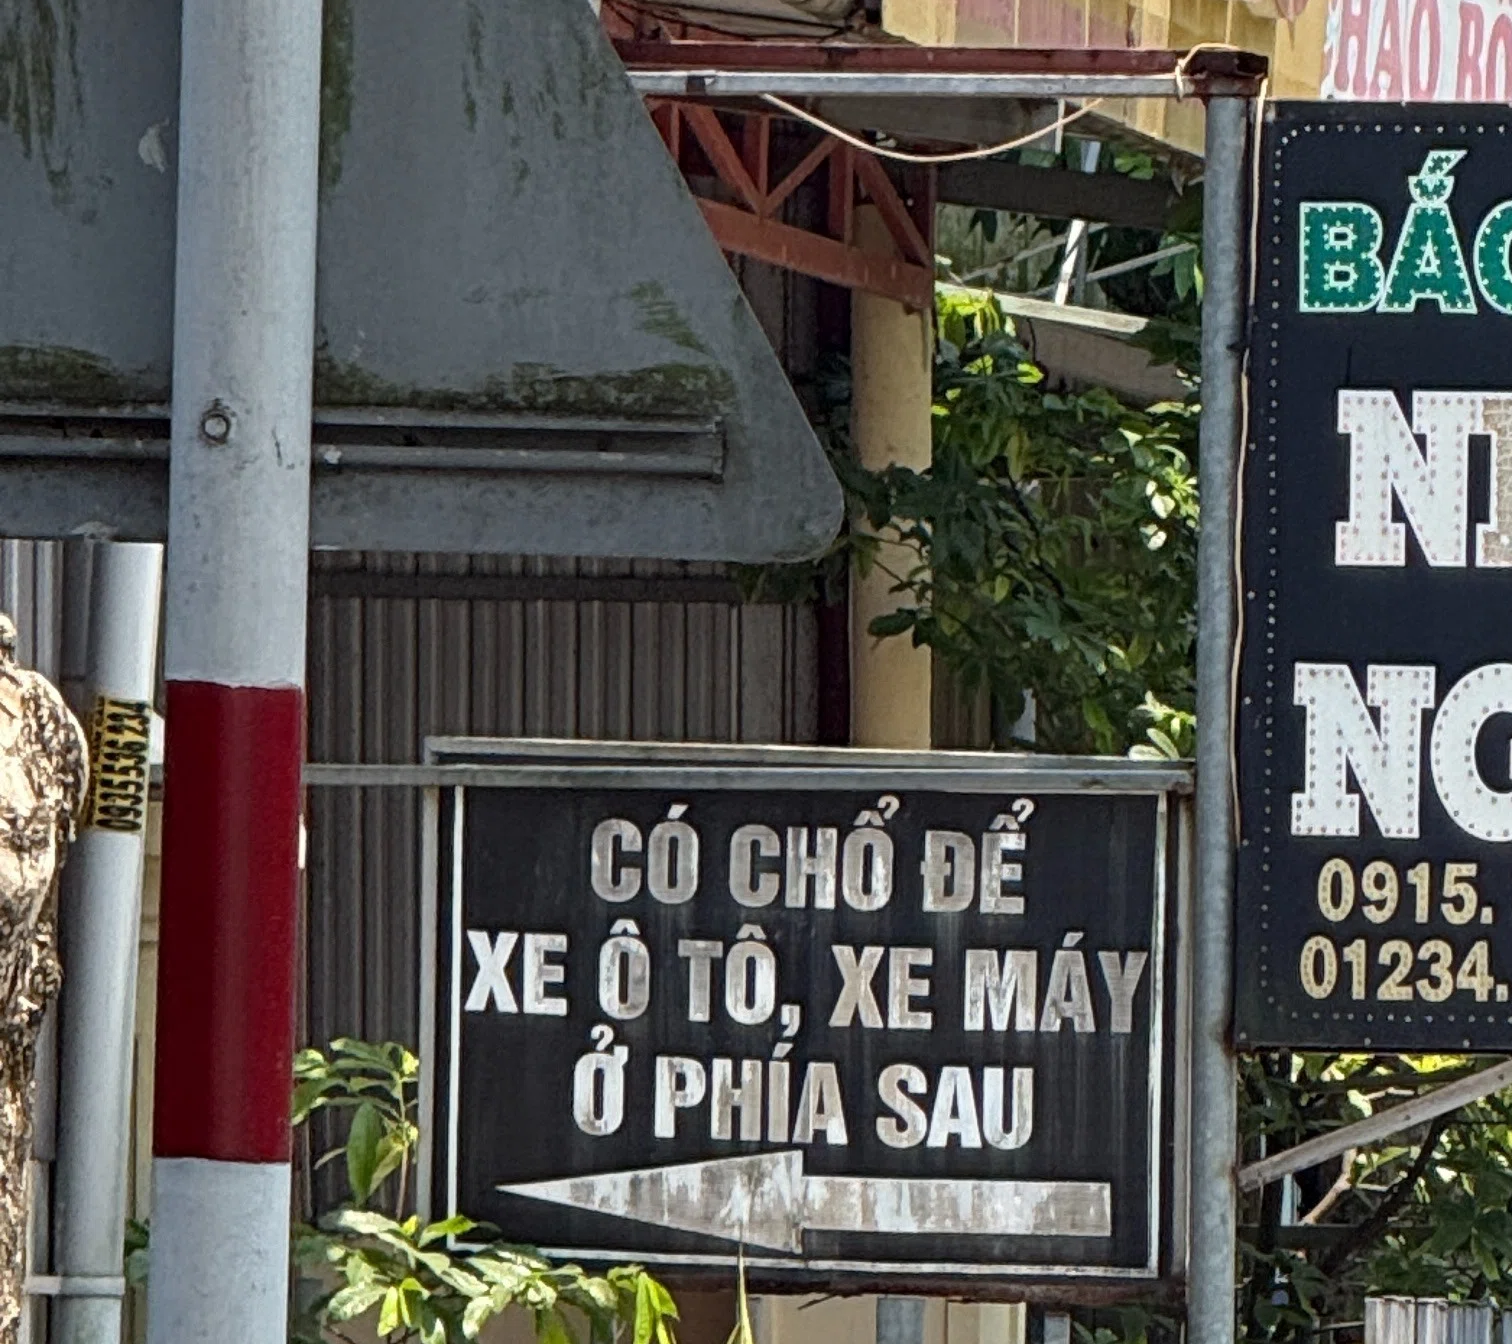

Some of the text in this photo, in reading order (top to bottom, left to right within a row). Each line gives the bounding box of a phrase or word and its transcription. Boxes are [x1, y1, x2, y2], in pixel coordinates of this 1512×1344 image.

[591, 804, 698, 904] CÓ
[920, 798, 1034, 914] ĐỂ
[1317, 858, 1493, 925] 0915.
[464, 918, 1147, 1037] XE Ô TÔ, XE MÁY
[1300, 935, 1508, 1003] 01234.
[573, 1025, 1034, 1149] Ở PHÍA SAU
